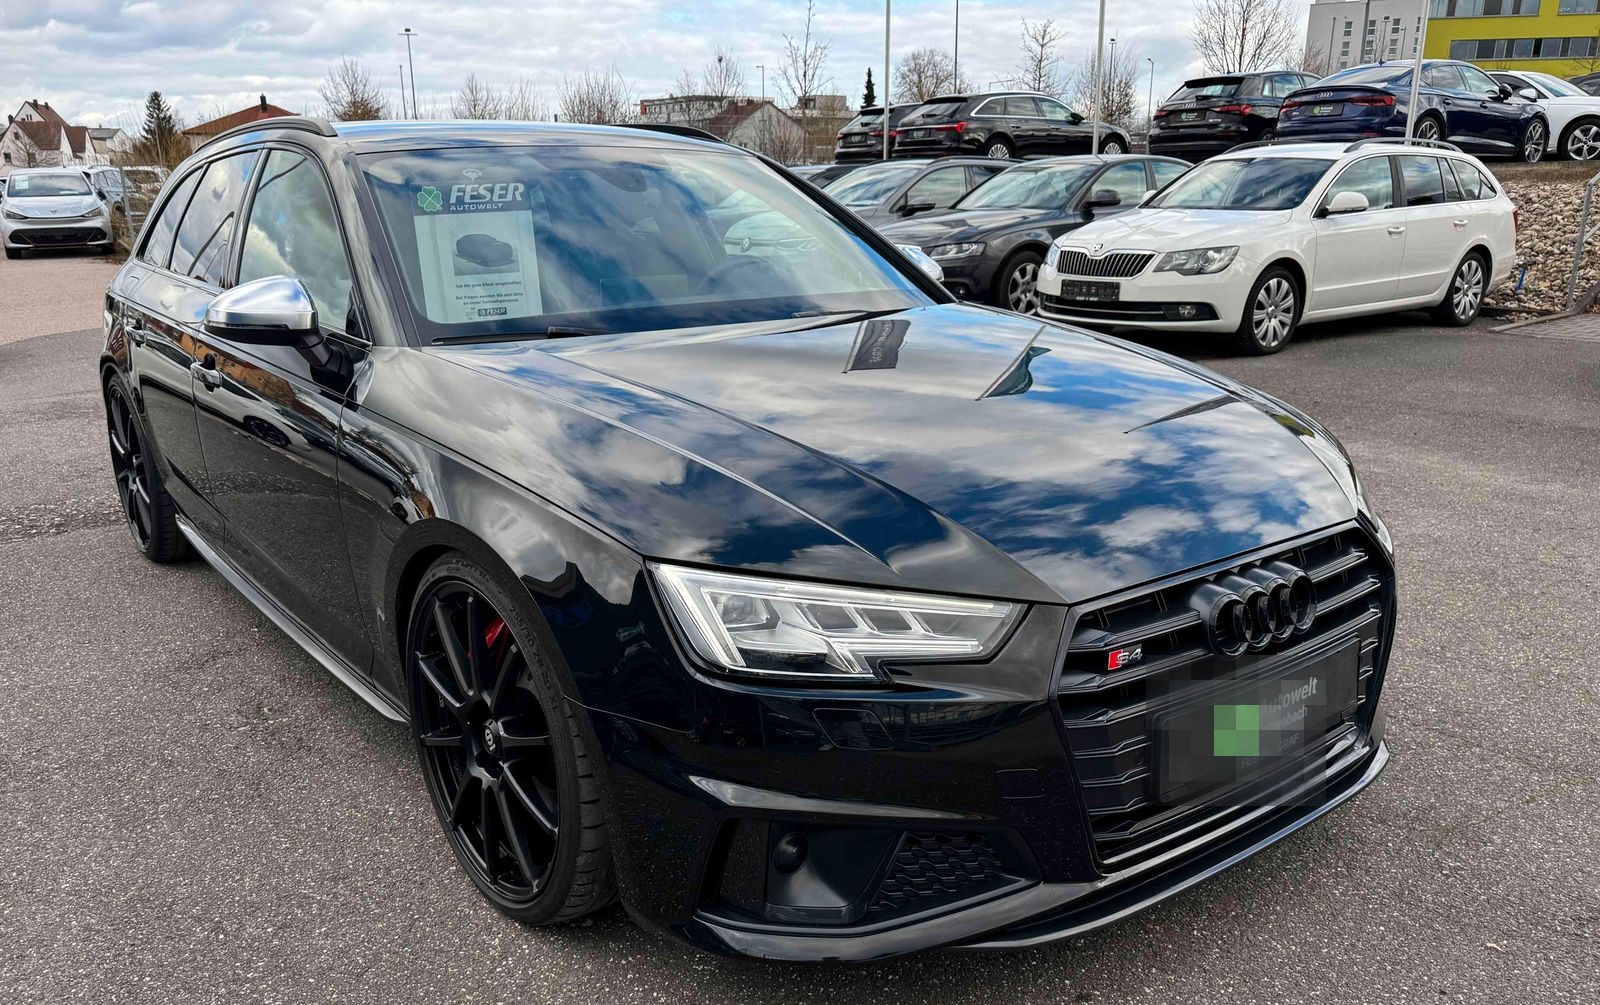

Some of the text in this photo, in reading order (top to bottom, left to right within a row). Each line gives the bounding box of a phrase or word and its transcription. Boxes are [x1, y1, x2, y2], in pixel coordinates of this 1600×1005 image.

[449, 183, 525, 204] FESER
[450, 203, 503, 212] AUTOWELT
[1112, 648, 1143, 666] S4
[1262, 676, 1318, 717] Autowelt
